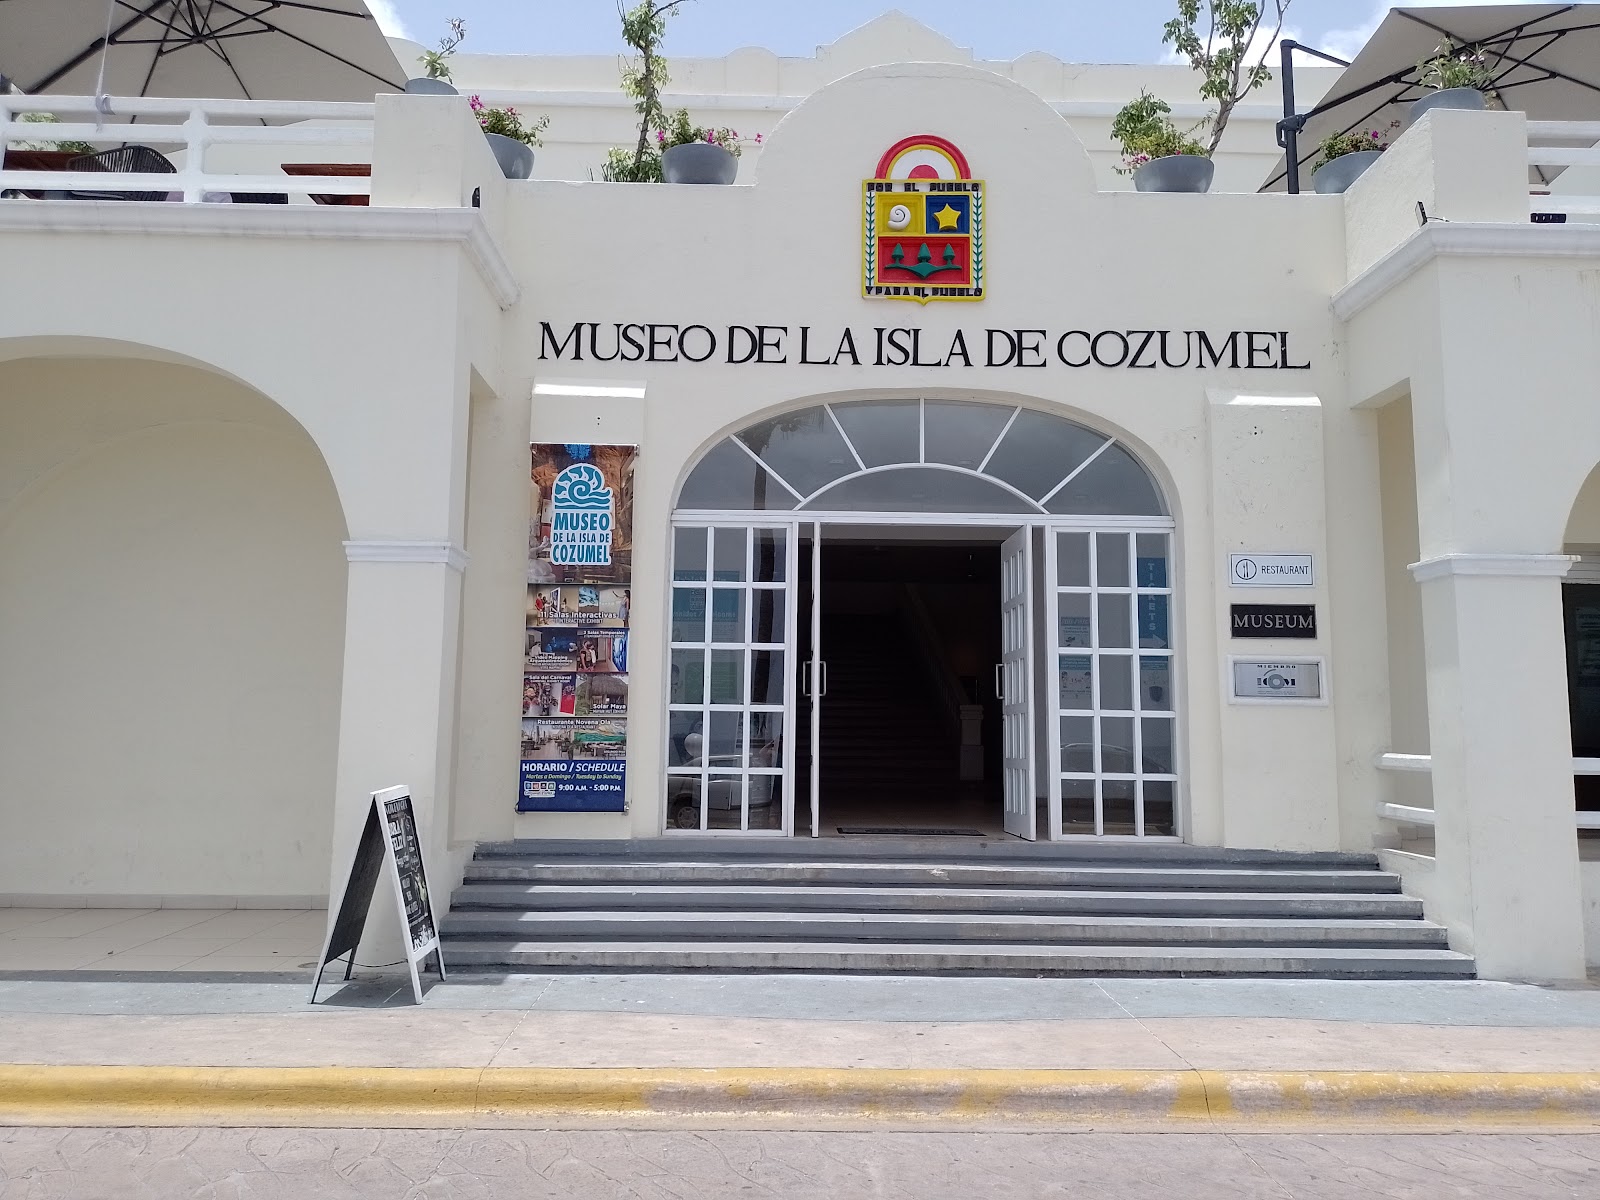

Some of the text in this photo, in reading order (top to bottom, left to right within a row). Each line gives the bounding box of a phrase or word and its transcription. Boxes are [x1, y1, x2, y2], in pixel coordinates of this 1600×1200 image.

[867, 182, 980, 192] POR EL PUEBLO
[865, 286, 983, 299] Y PARA EL PUEBLO
[537, 321, 1311, 370] MUSEO DE LA ISLA DE COZUMEL
[553, 512, 610, 531] MUSEO
[553, 532, 610, 543] DE LA ISLA DE
[552, 544, 609, 563] COZUMEL
[1261, 565, 1309, 575] RESTAURANT
[1147, 562, 1157, 632] TICKETS
[549, 611, 570, 619] Salas
[571, 611, 618, 619] Interactivas
[1233, 614, 1314, 629] MUSEUM
[522, 762, 626, 773] HORARIO / SCHEDULE
